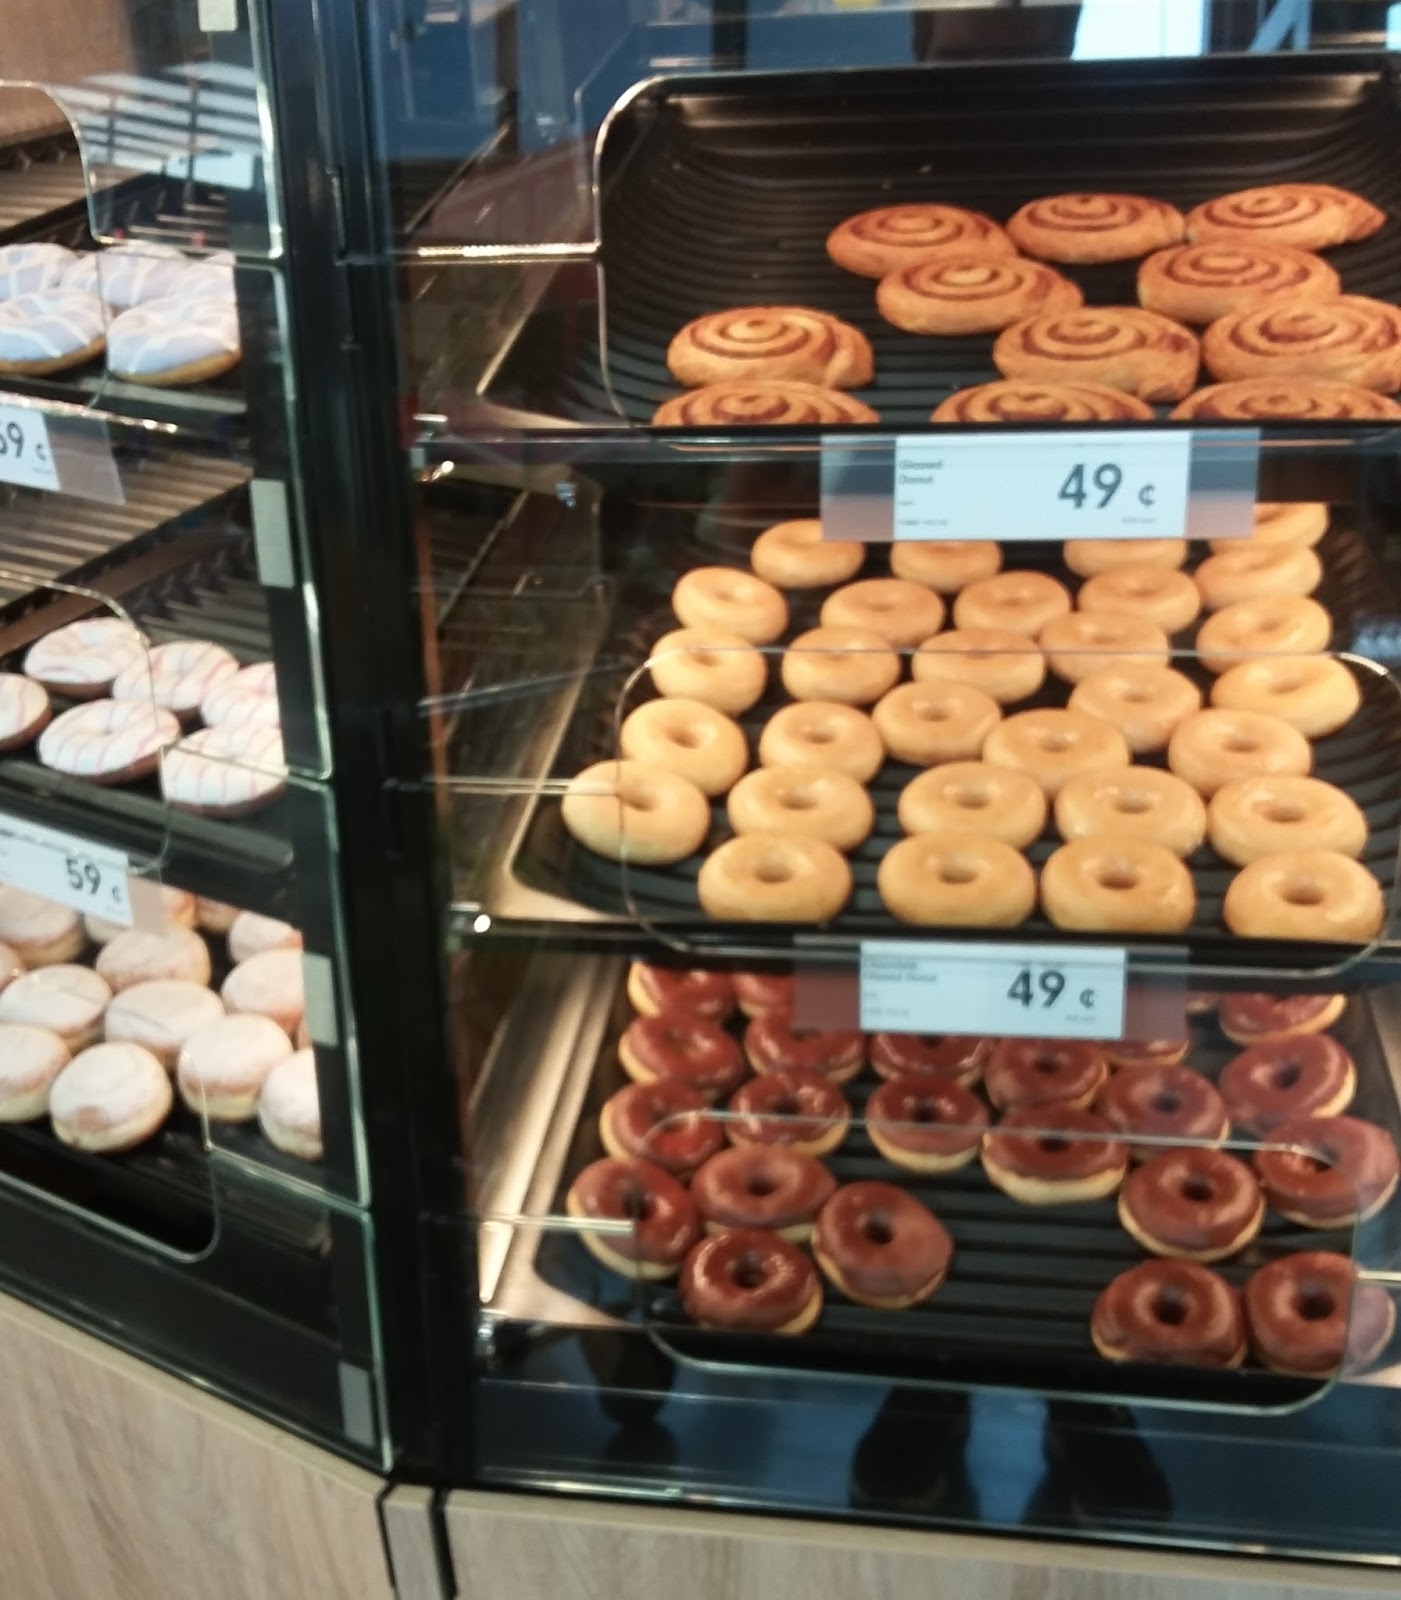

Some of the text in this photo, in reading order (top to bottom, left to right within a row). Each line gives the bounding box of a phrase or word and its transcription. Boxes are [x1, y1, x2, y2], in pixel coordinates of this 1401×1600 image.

[1057, 462, 1123, 509] 49
[65, 857, 101, 895] 59
[1006, 968, 1066, 1009] 49
